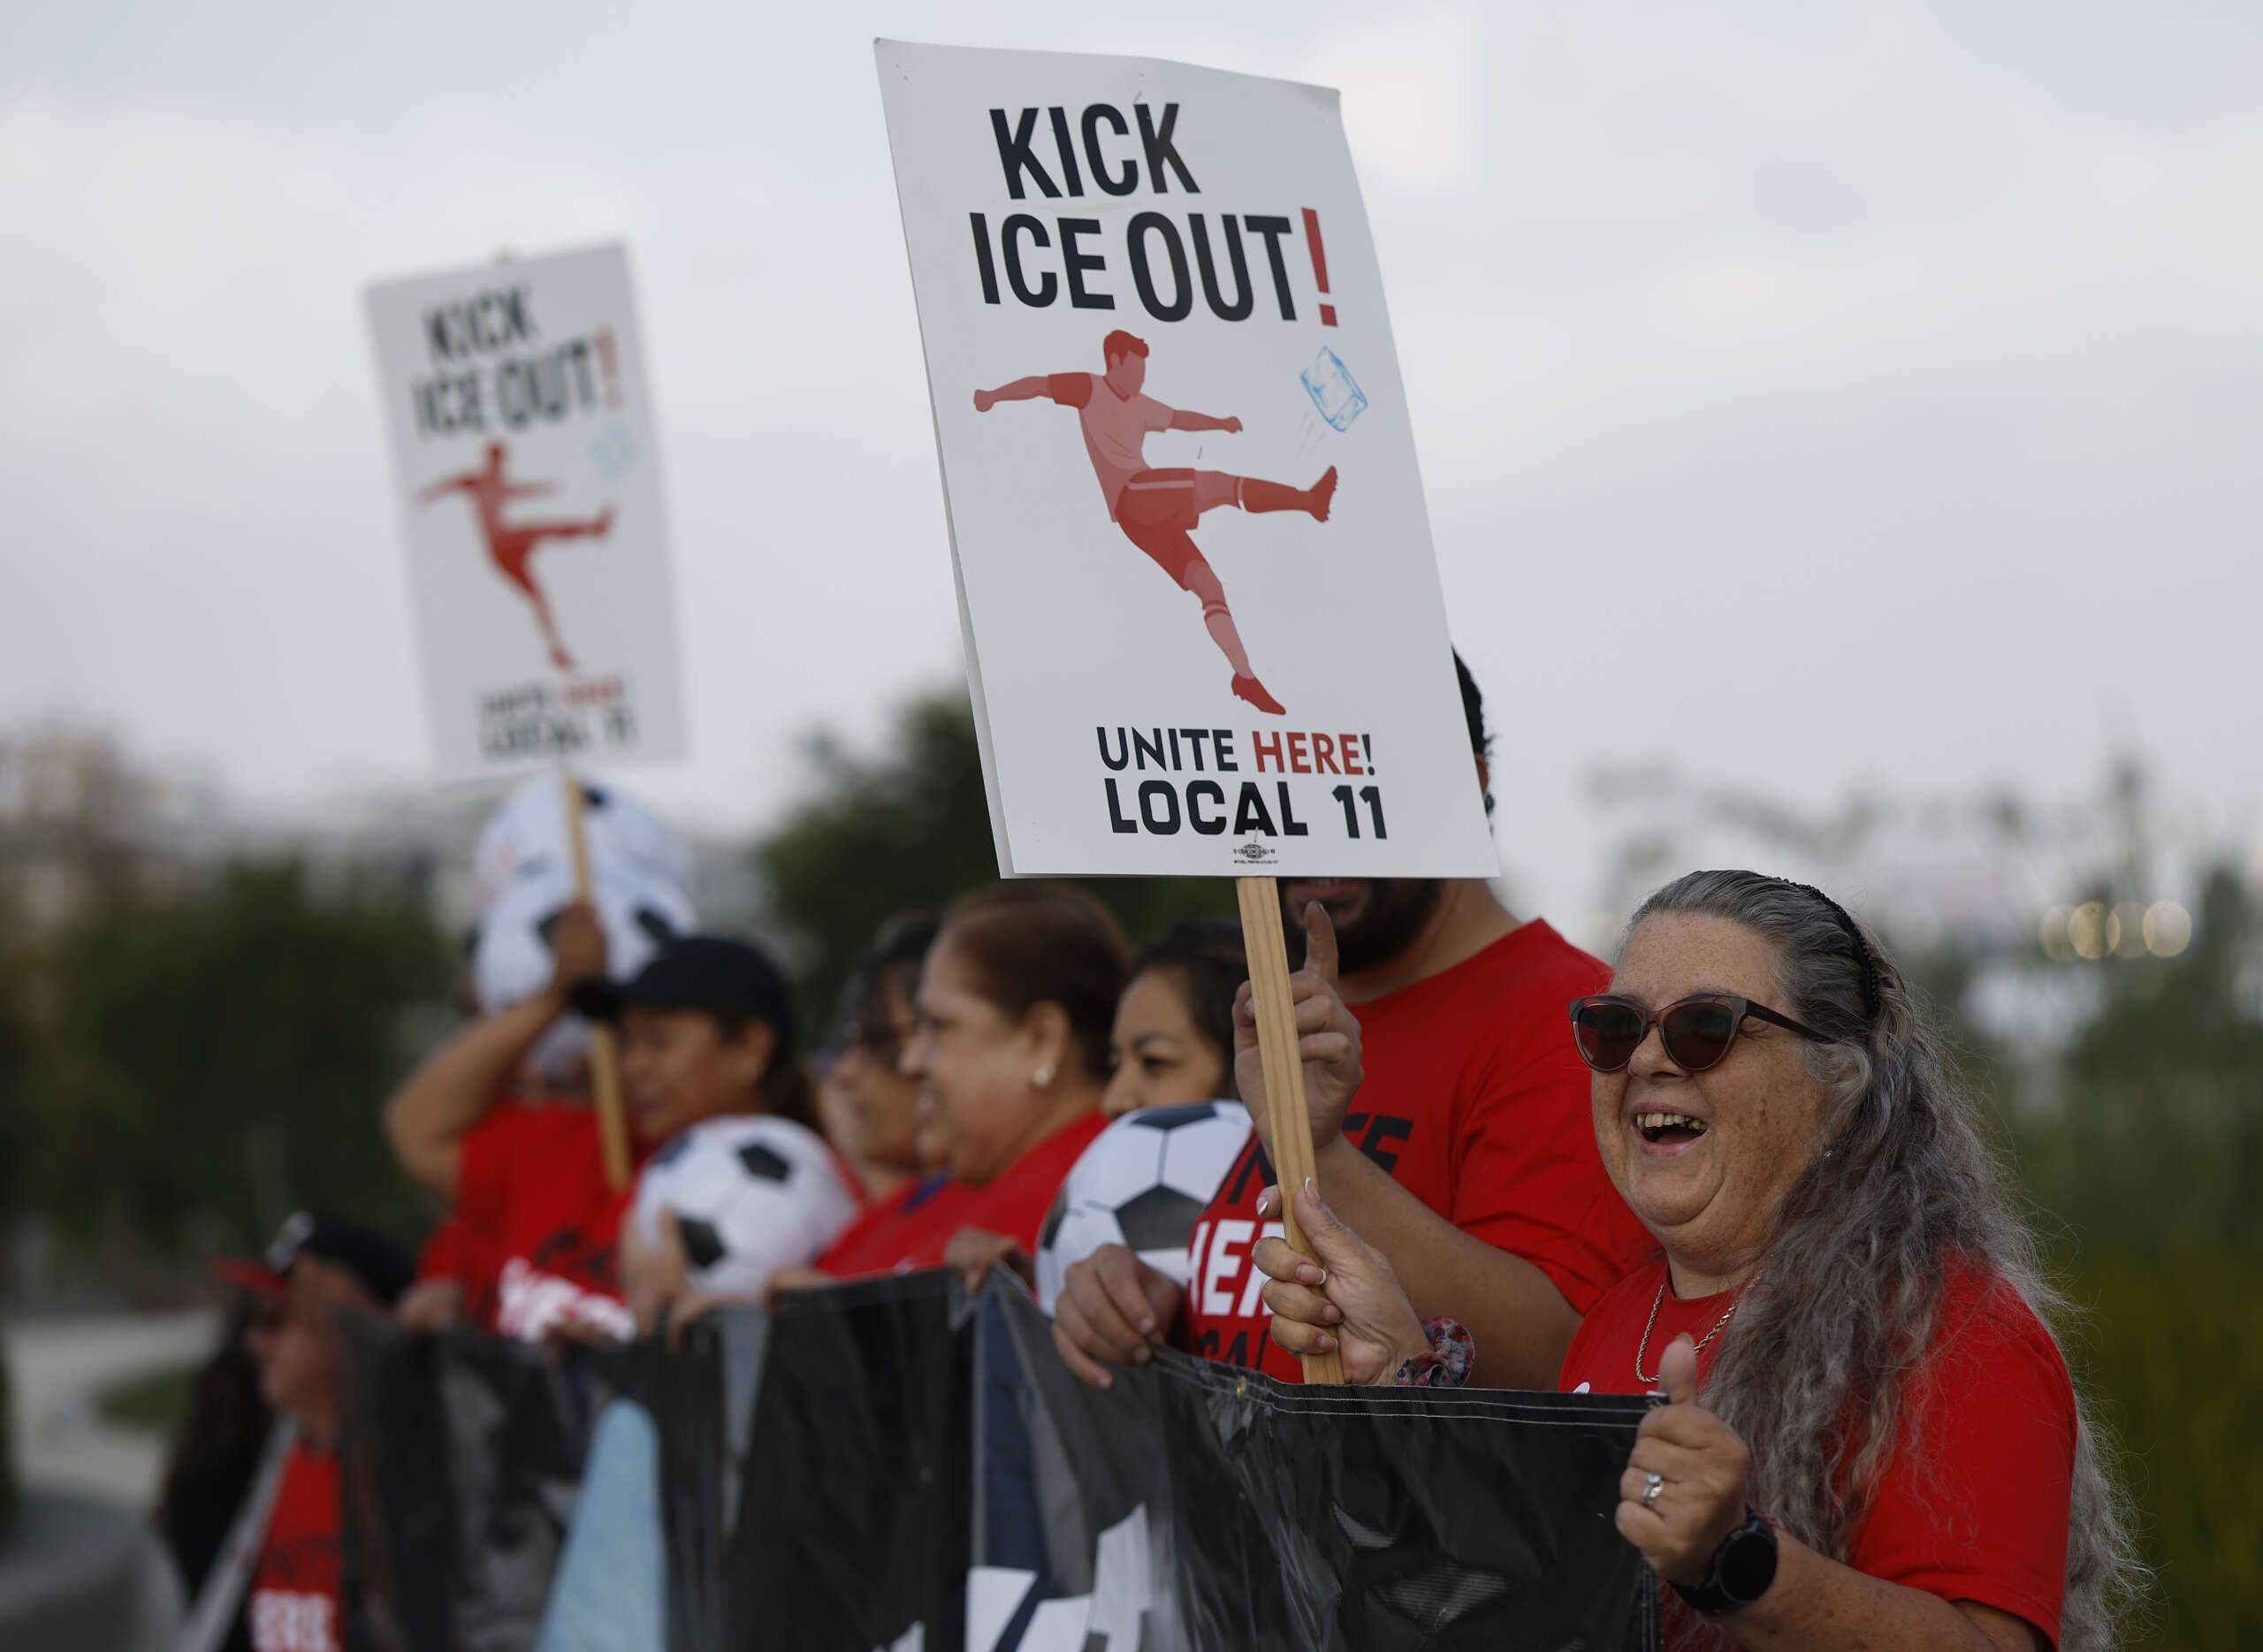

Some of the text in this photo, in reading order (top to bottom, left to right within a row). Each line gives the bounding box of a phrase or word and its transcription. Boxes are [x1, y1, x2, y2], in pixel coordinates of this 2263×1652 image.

[988, 103, 1201, 200] KICK
[969, 208, 1338, 327] ICE OUT!
[1095, 726, 1376, 776] UNITE HERE!
[1103, 777, 1388, 840] LOCAL 11
